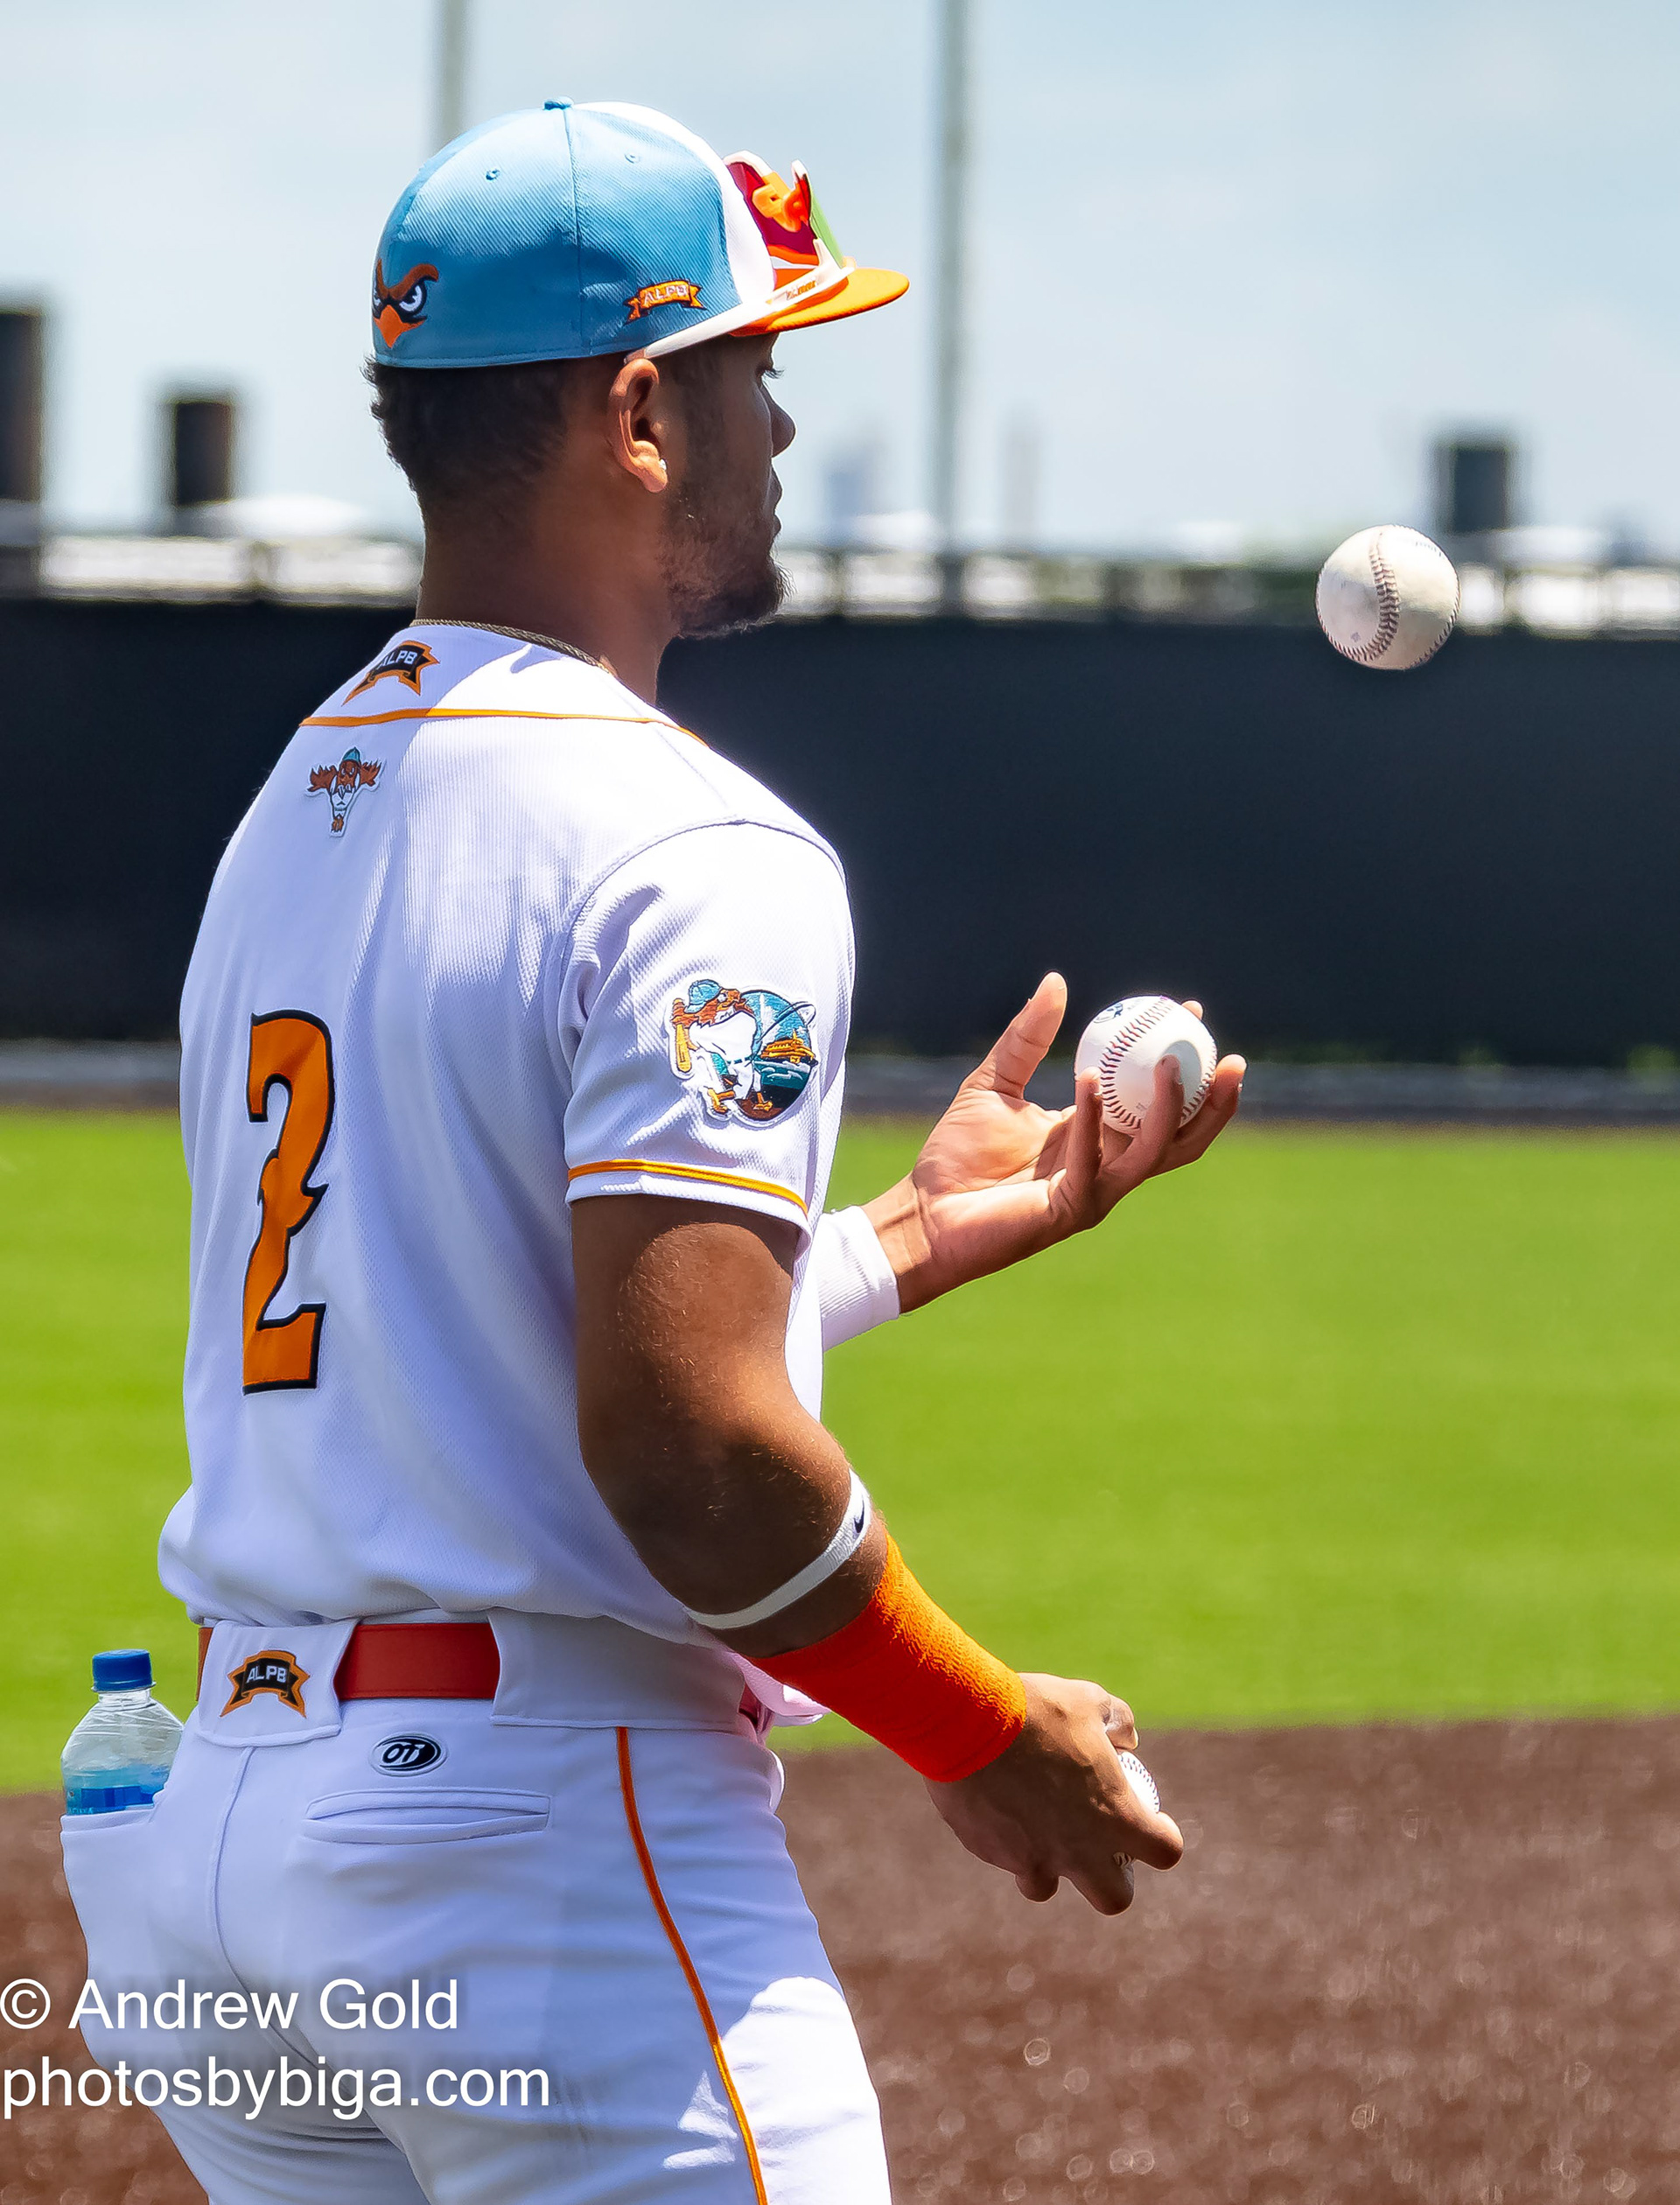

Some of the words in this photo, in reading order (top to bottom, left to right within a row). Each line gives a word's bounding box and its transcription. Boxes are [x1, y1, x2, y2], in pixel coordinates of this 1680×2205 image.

[644, 284, 688, 305] ALPB
[375, 650, 417, 670] ALPB
[243, 1009, 335, 1396] 2
[246, 1665, 287, 1684] ALPB
